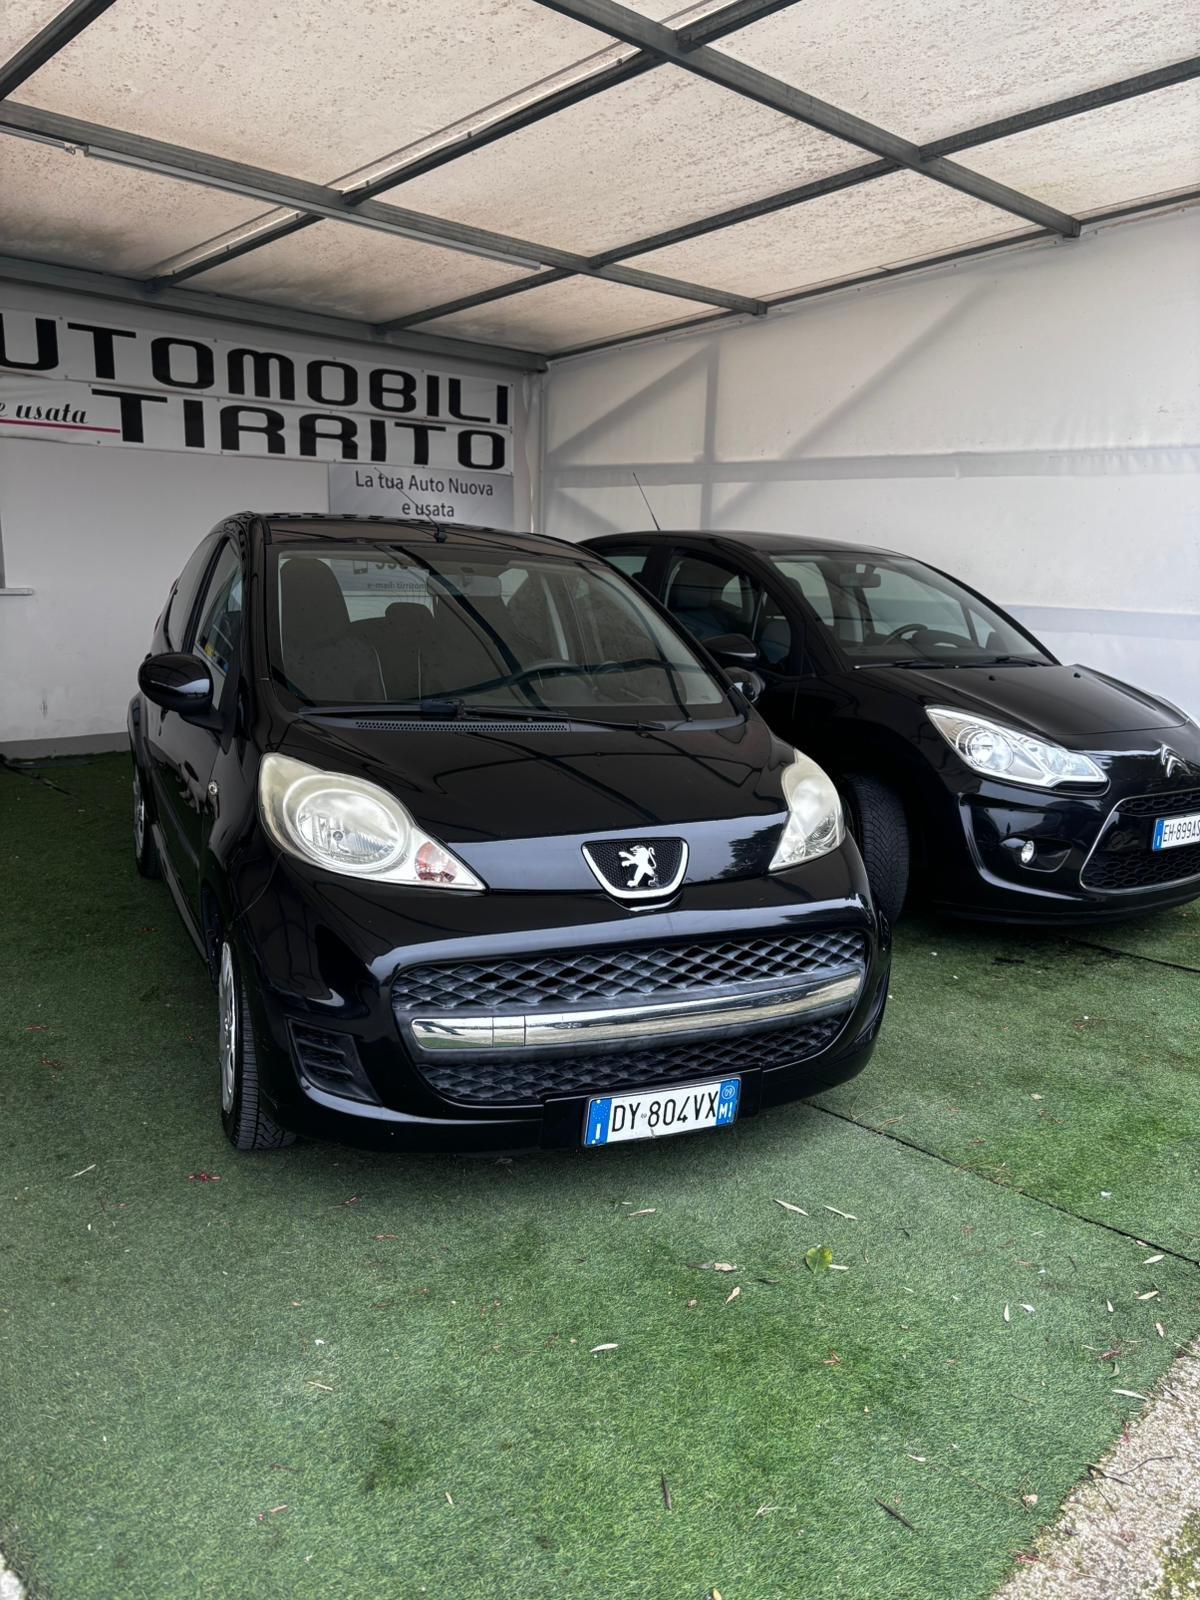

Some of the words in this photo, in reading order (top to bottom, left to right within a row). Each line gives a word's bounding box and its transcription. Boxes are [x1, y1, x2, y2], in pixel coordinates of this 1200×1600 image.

[0, 313, 508, 425] UTOMOBILI
[15, 403, 88, 424] usata
[91, 388, 505, 470] TIRRITO
[355, 470, 374, 488] La
[379, 473, 404, 490] tua
[408, 475, 445, 493] Auto
[449, 477, 494, 496] Nuova
[402, 503, 411, 515] e
[415, 501, 455, 517] usata
[647, 1091, 719, 1128] 804VX
[718, 1101, 734, 1120] MI
